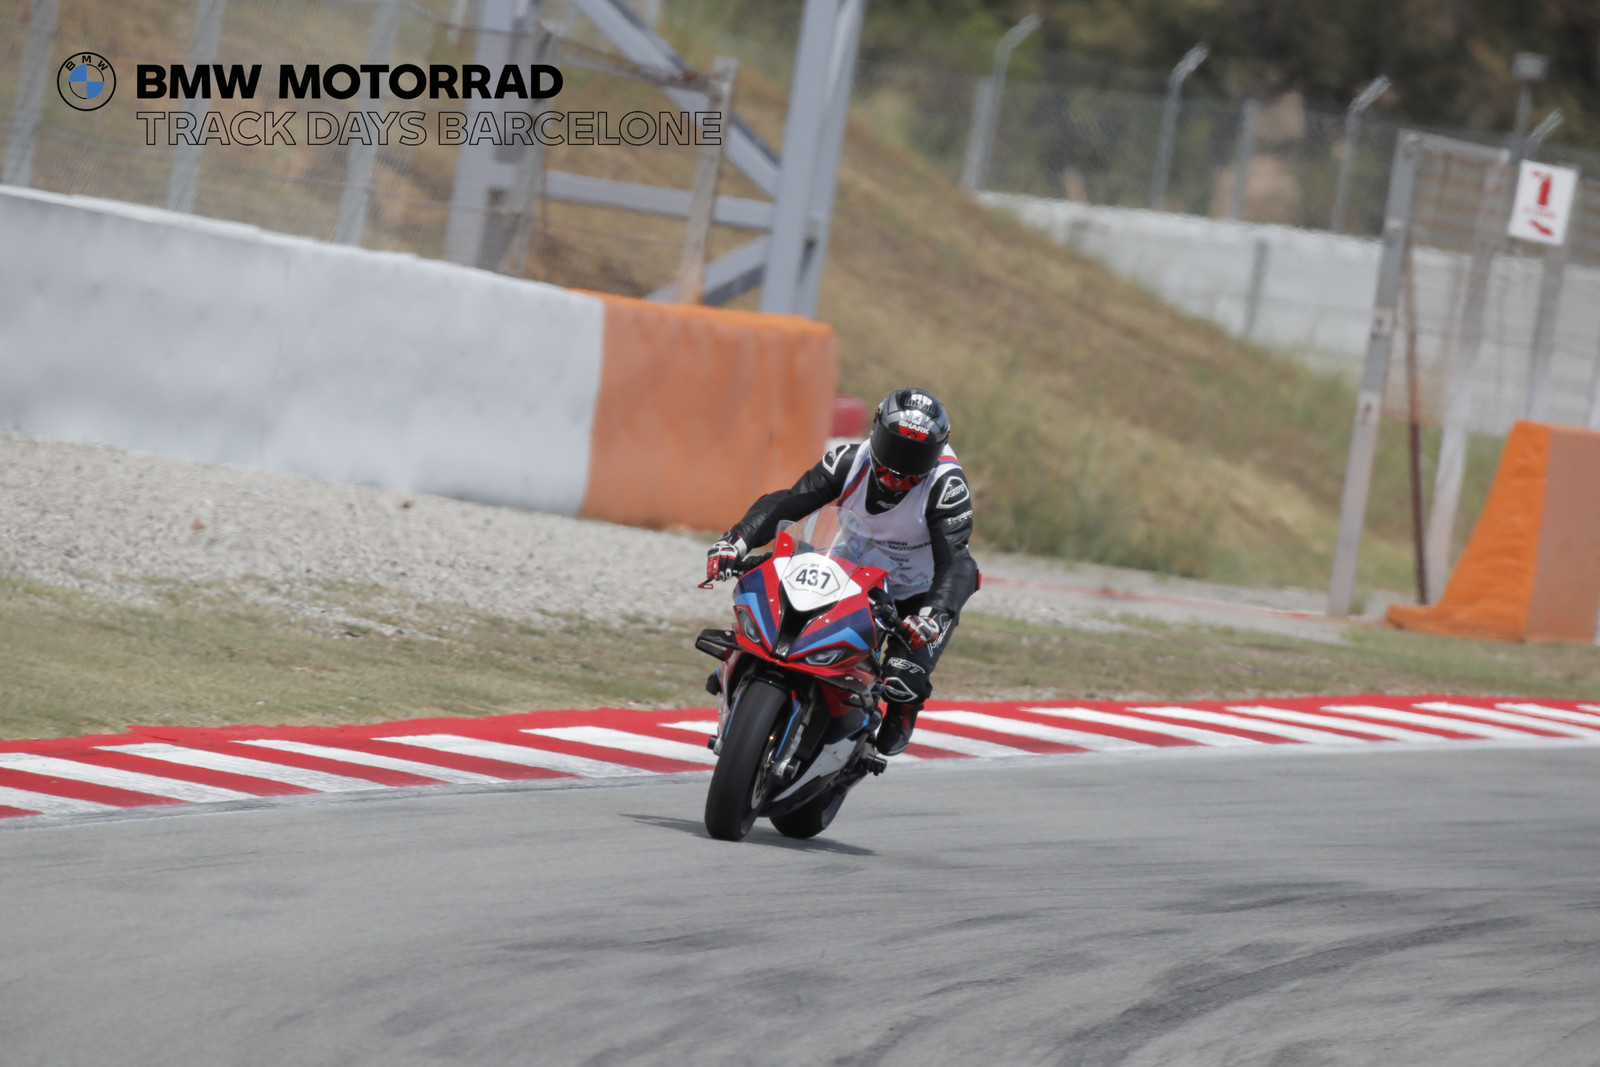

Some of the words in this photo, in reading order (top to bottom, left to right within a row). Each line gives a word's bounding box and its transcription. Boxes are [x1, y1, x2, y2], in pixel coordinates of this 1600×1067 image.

[898, 419, 930, 435] SHARK
[795, 568, 831, 590] 437
[887, 656, 927, 674] RST
